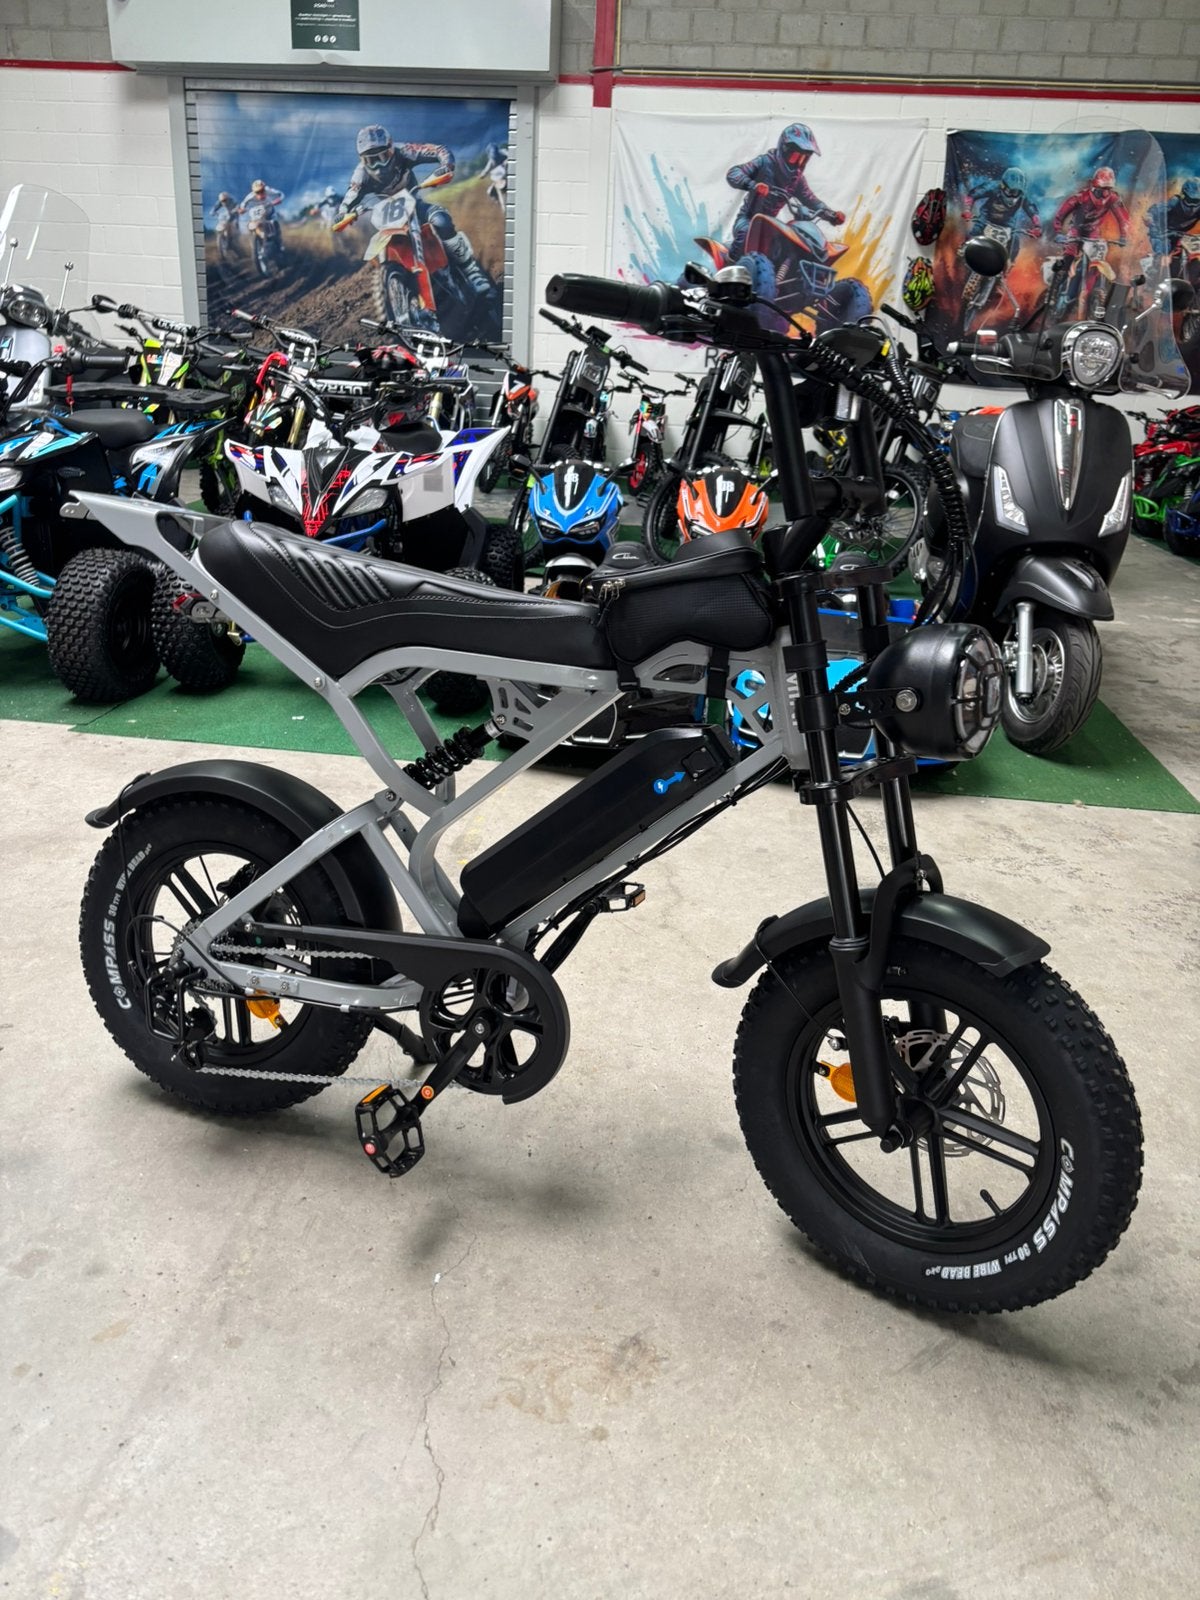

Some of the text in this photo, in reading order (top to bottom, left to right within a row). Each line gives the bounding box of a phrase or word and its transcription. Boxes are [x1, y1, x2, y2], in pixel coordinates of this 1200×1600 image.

[381, 197, 406, 224] 18
[103, 917, 132, 1010] COMPASS
[127, 850, 146, 874] BEAD
[1032, 1138, 1075, 1254] COMPASS
[940, 1265, 972, 1280] BEAD
[973, 1258, 1002, 1278] WIRE
